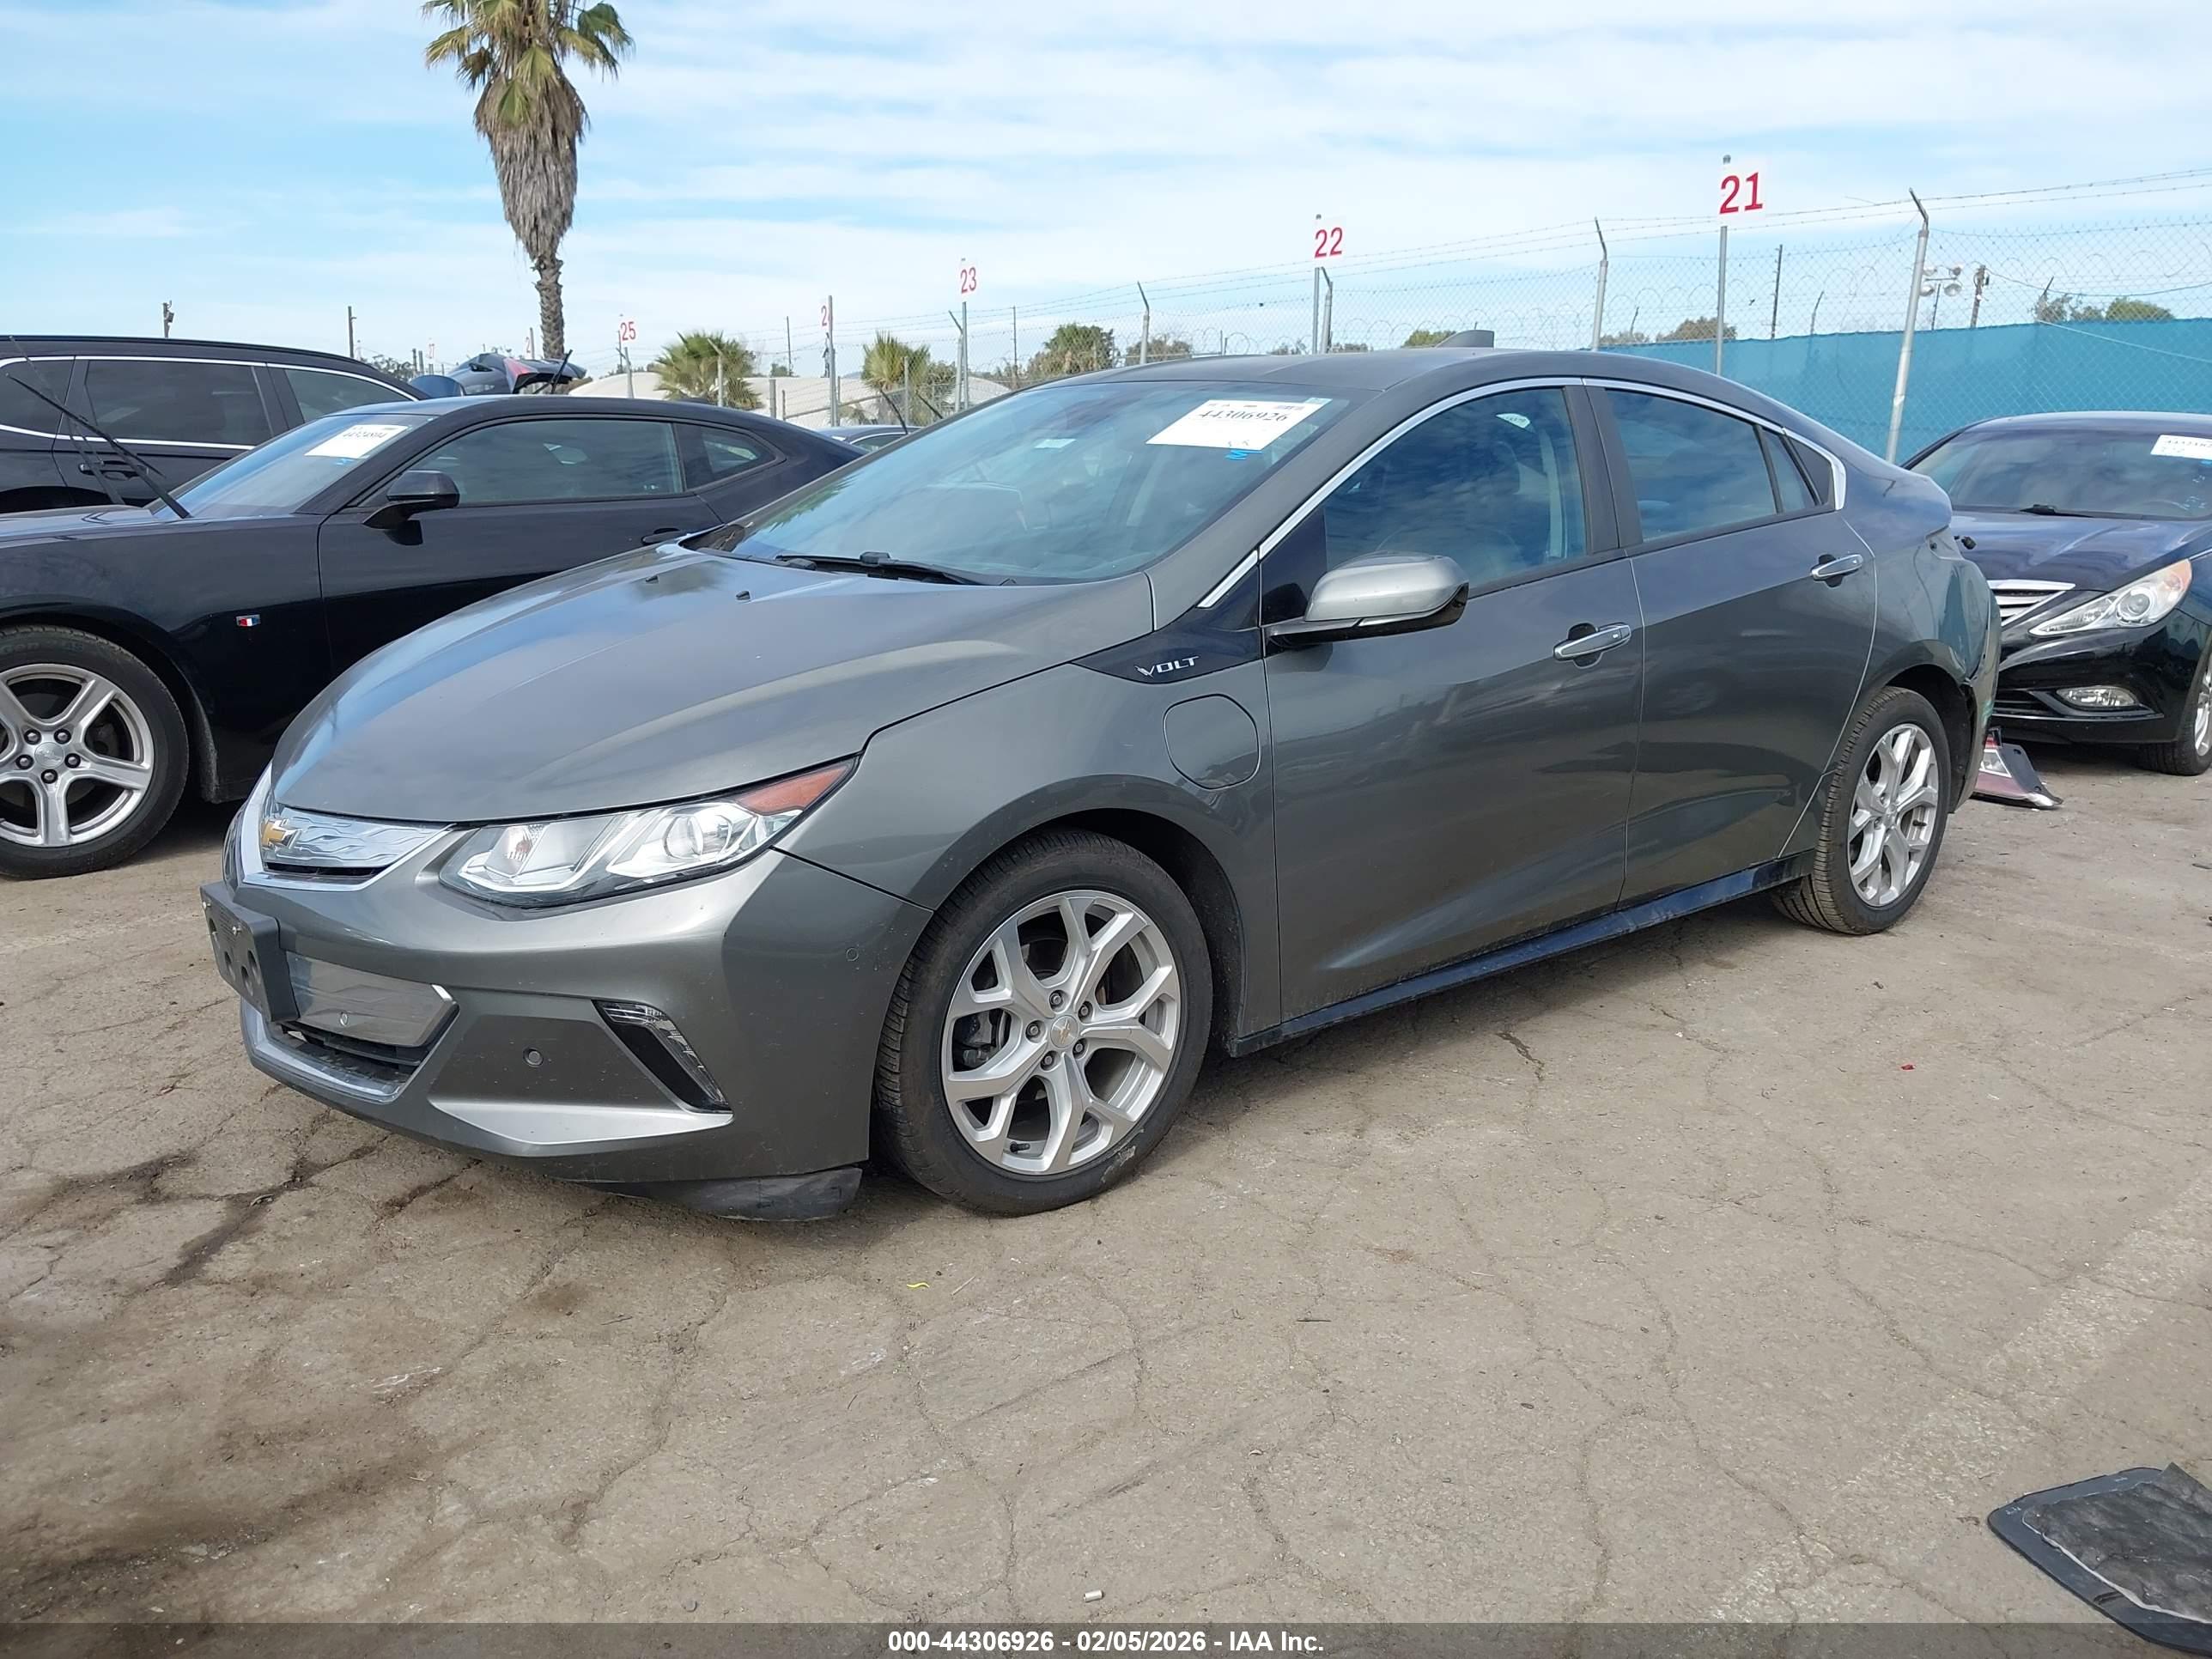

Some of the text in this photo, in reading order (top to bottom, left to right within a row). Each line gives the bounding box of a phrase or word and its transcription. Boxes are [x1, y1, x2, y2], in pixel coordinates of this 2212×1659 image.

[1719, 172, 1764, 215] 21
[1315, 227, 1344, 258] 22
[960, 266, 977, 294] 23
[620, 321, 636, 341] 25
[1199, 410, 1289, 422] 44306926
[1134, 655, 1200, 678] VOLT
